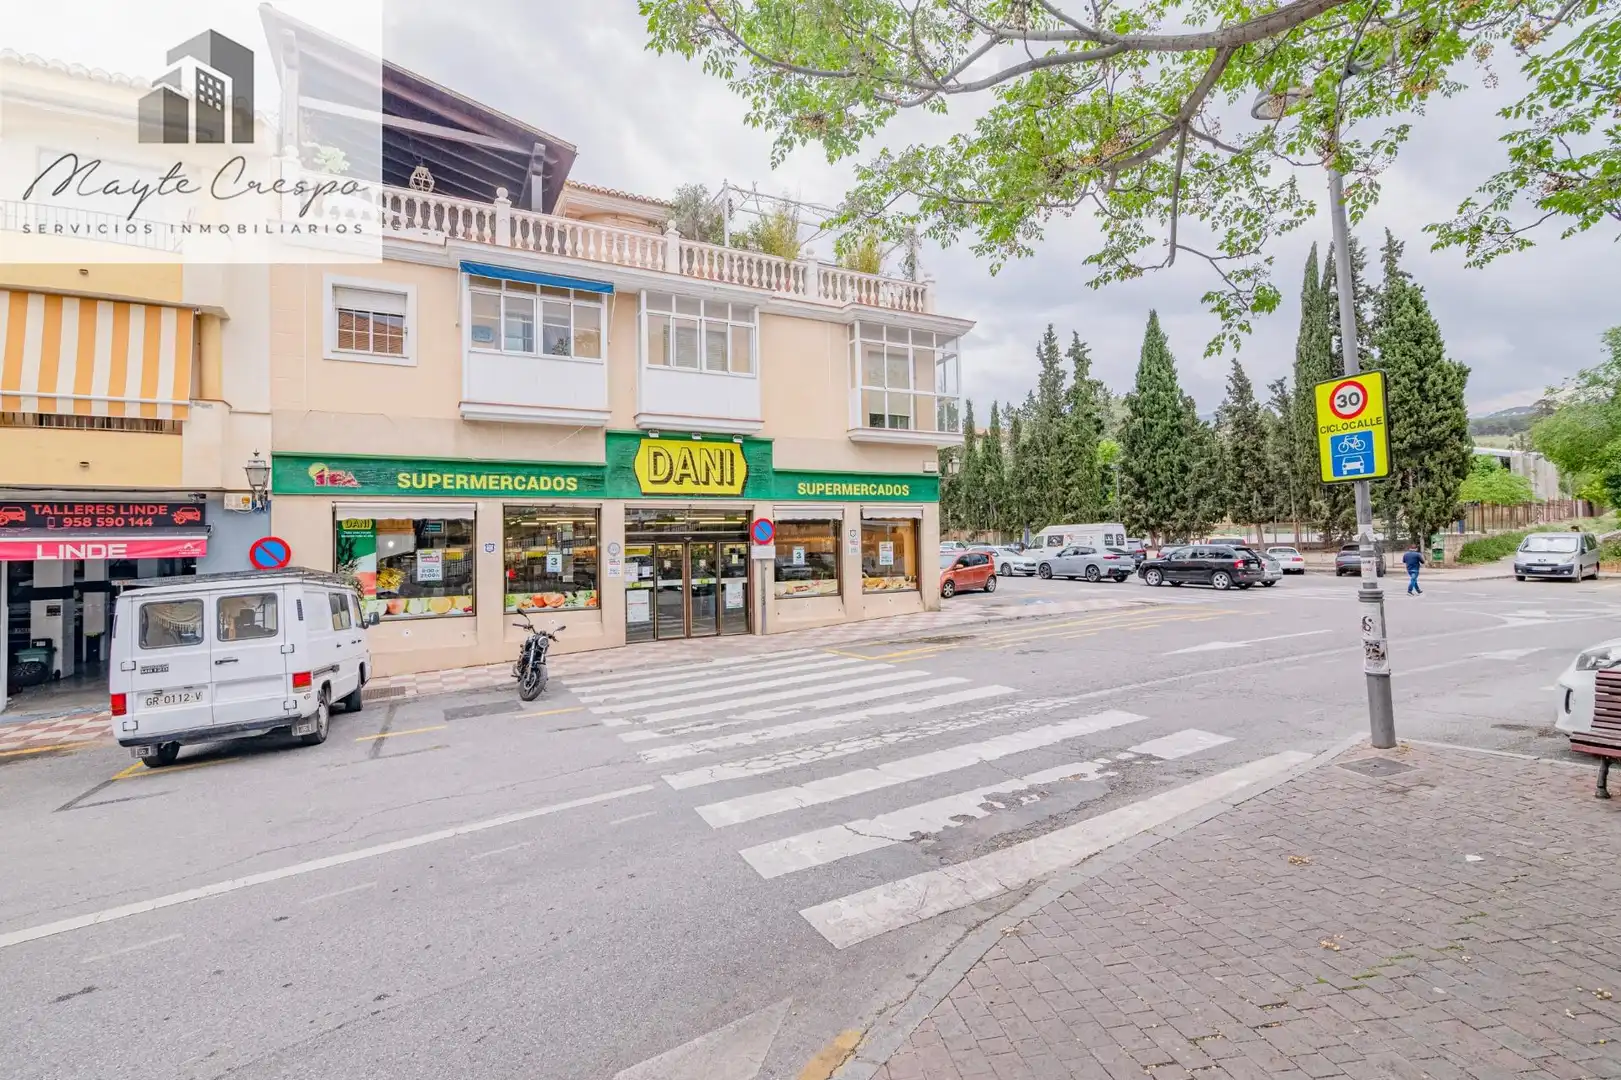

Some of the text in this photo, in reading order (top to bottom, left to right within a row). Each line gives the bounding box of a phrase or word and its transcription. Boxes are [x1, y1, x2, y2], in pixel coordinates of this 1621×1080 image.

[1336, 391, 1360, 409] 30
[1319, 416, 1383, 434] CICLOCALLE
[647, 444, 737, 488] DANI
[397, 472, 578, 491] SUPERMERCADOS
[797, 482, 910, 497] SUPERMERCADOS
[31, 504, 168, 515] TALLERES LINDE
[63, 517, 153, 527] 958 590 144
[344, 518, 371, 529] DANI
[37, 543, 127, 560] LINDE
[550, 557, 558, 566] 3
